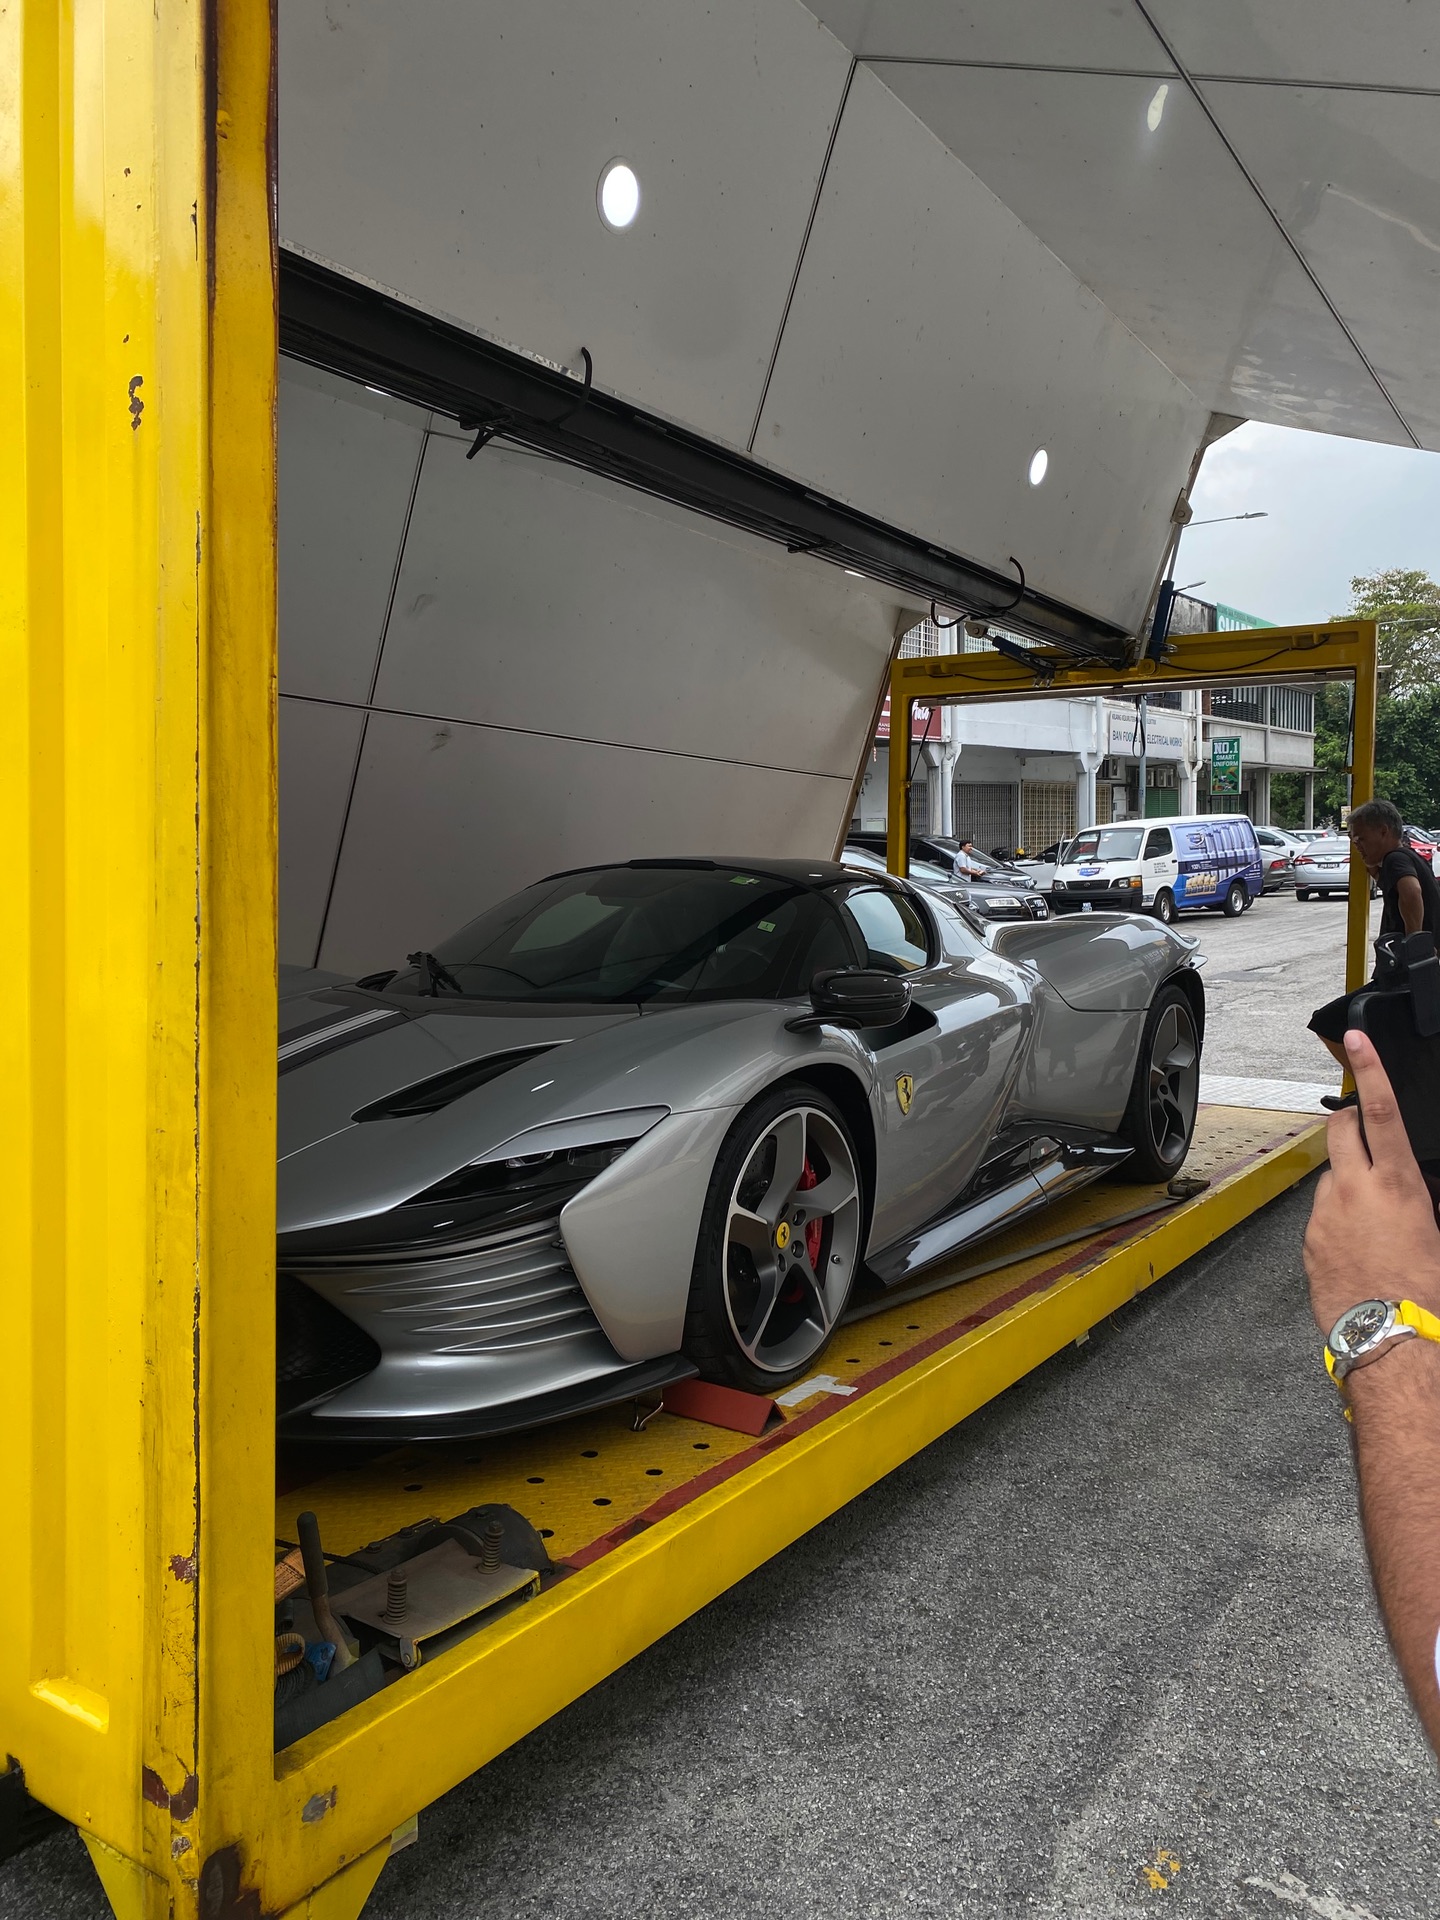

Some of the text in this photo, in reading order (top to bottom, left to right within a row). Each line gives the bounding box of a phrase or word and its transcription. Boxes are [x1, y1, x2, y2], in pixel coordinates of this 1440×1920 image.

[1113, 730, 1122, 741] BAN
[1147, 734, 1169, 746] ELECTRICAL
[1214, 742, 1238, 754] NO.1
